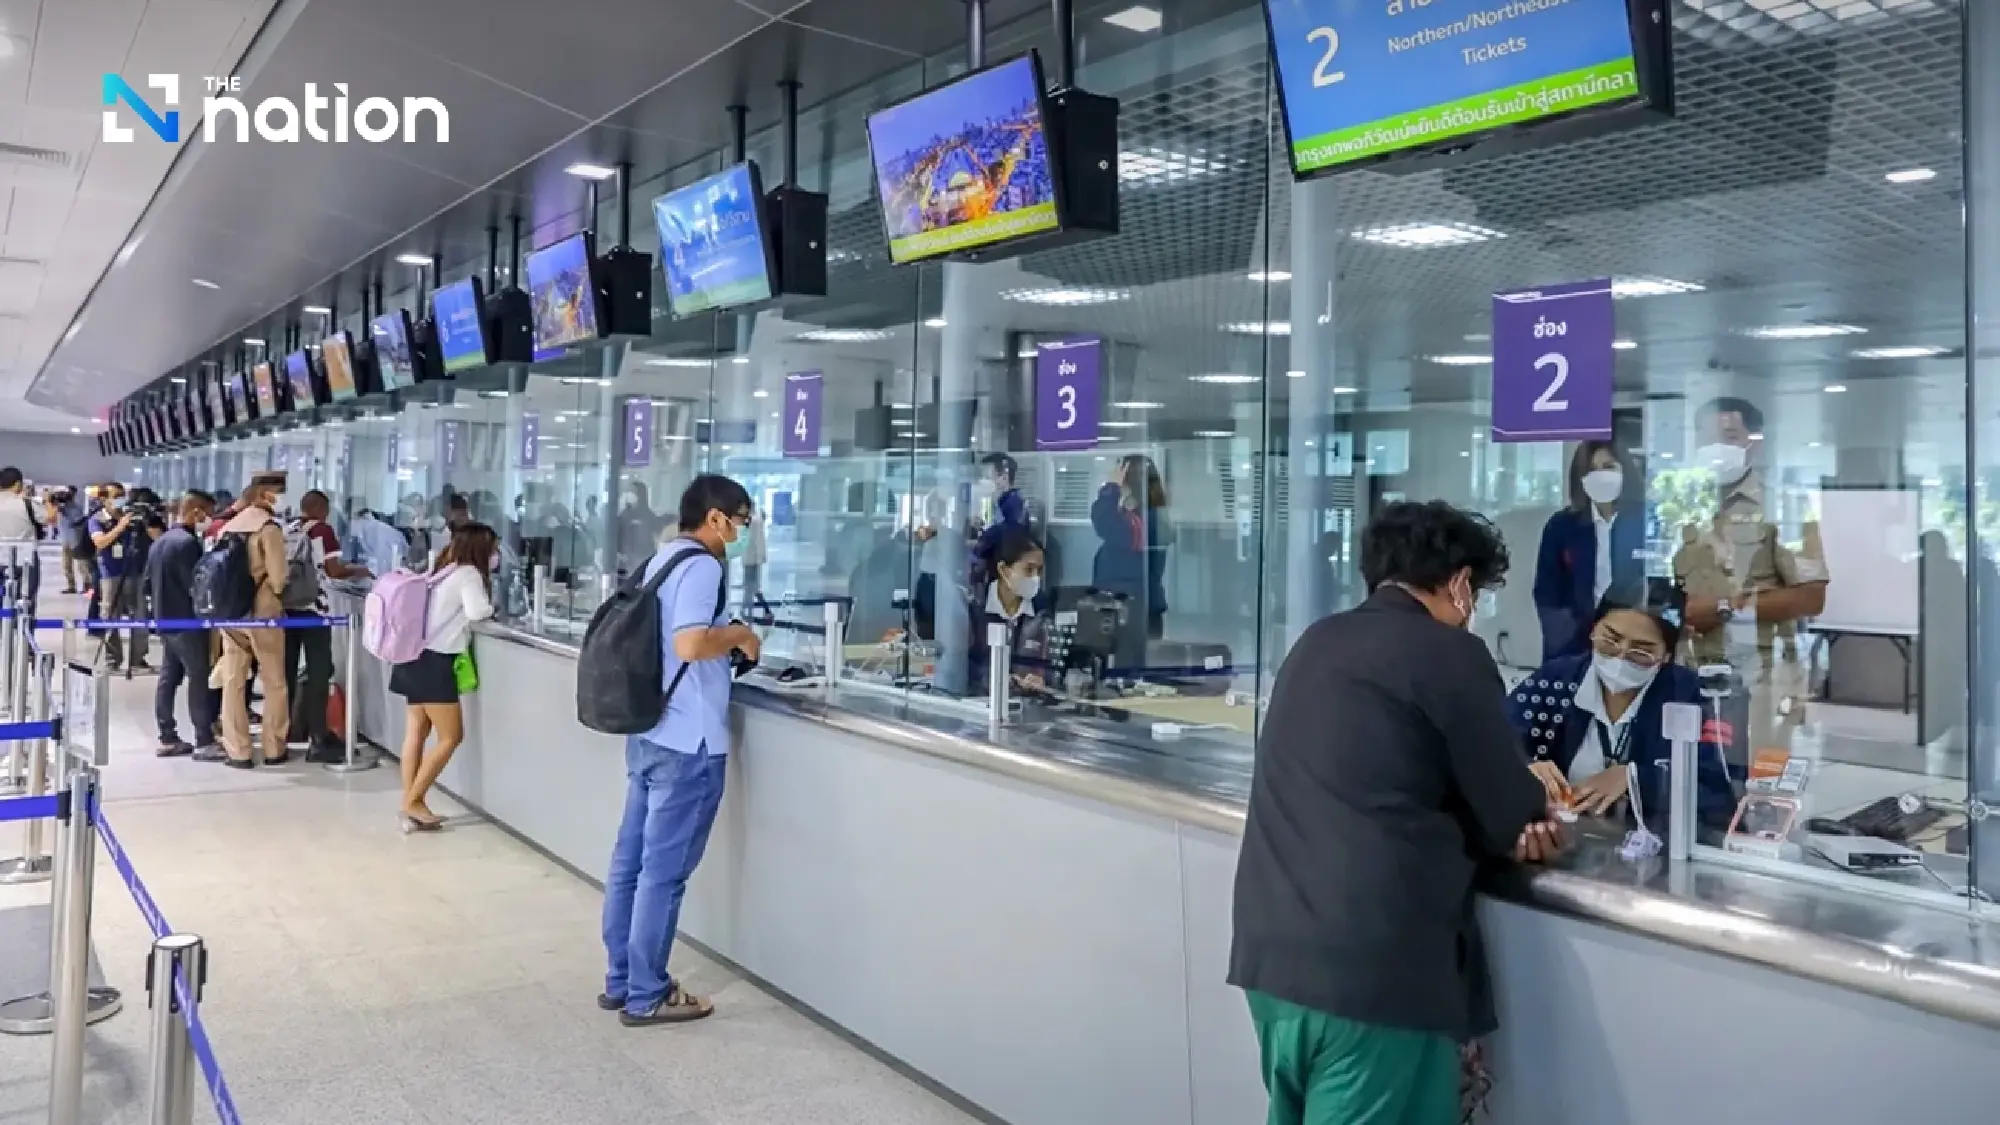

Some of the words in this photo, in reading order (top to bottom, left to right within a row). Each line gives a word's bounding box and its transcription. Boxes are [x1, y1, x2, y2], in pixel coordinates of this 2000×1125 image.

[1306, 26, 1345, 88] 2
[1461, 36, 1528, 66] Tickets
[1533, 315, 1567, 338] ช่อง
[1532, 352, 1569, 412] 2
[1057, 385, 1077, 429] 3
[634, 426, 643, 454] 5
[794, 408, 808, 442] 4
